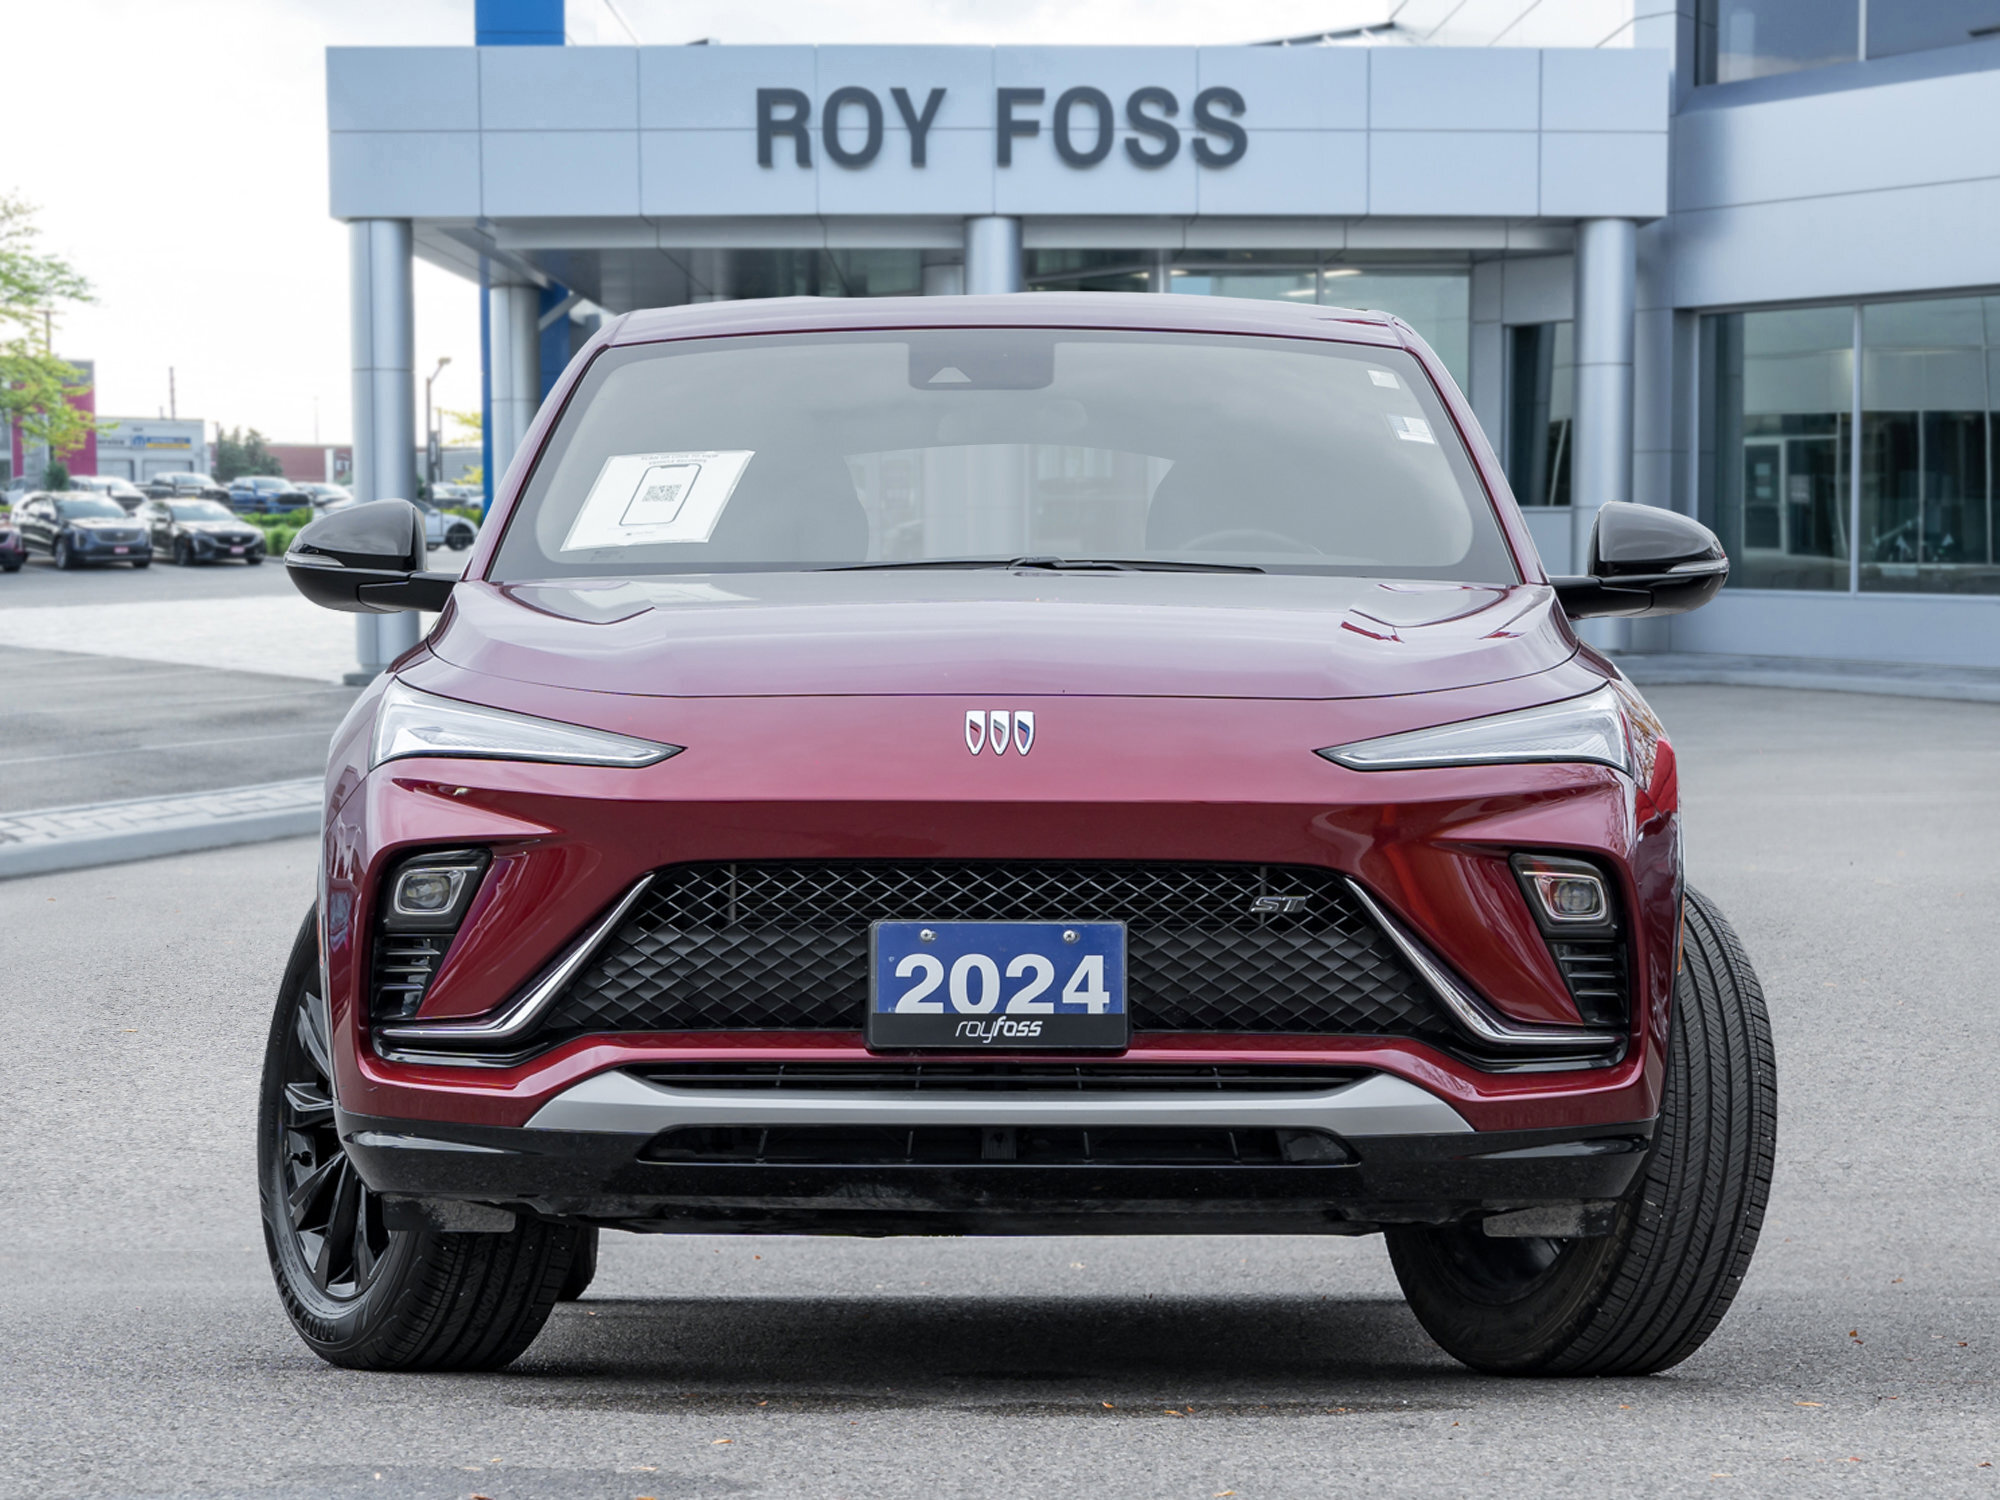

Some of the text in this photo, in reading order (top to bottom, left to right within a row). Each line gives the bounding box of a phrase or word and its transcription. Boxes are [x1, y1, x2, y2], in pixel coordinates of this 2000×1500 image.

[756, 86, 1249, 169] ROY FOSS
[1250, 895, 1307, 913] ST
[895, 953, 1111, 1014] 2024
